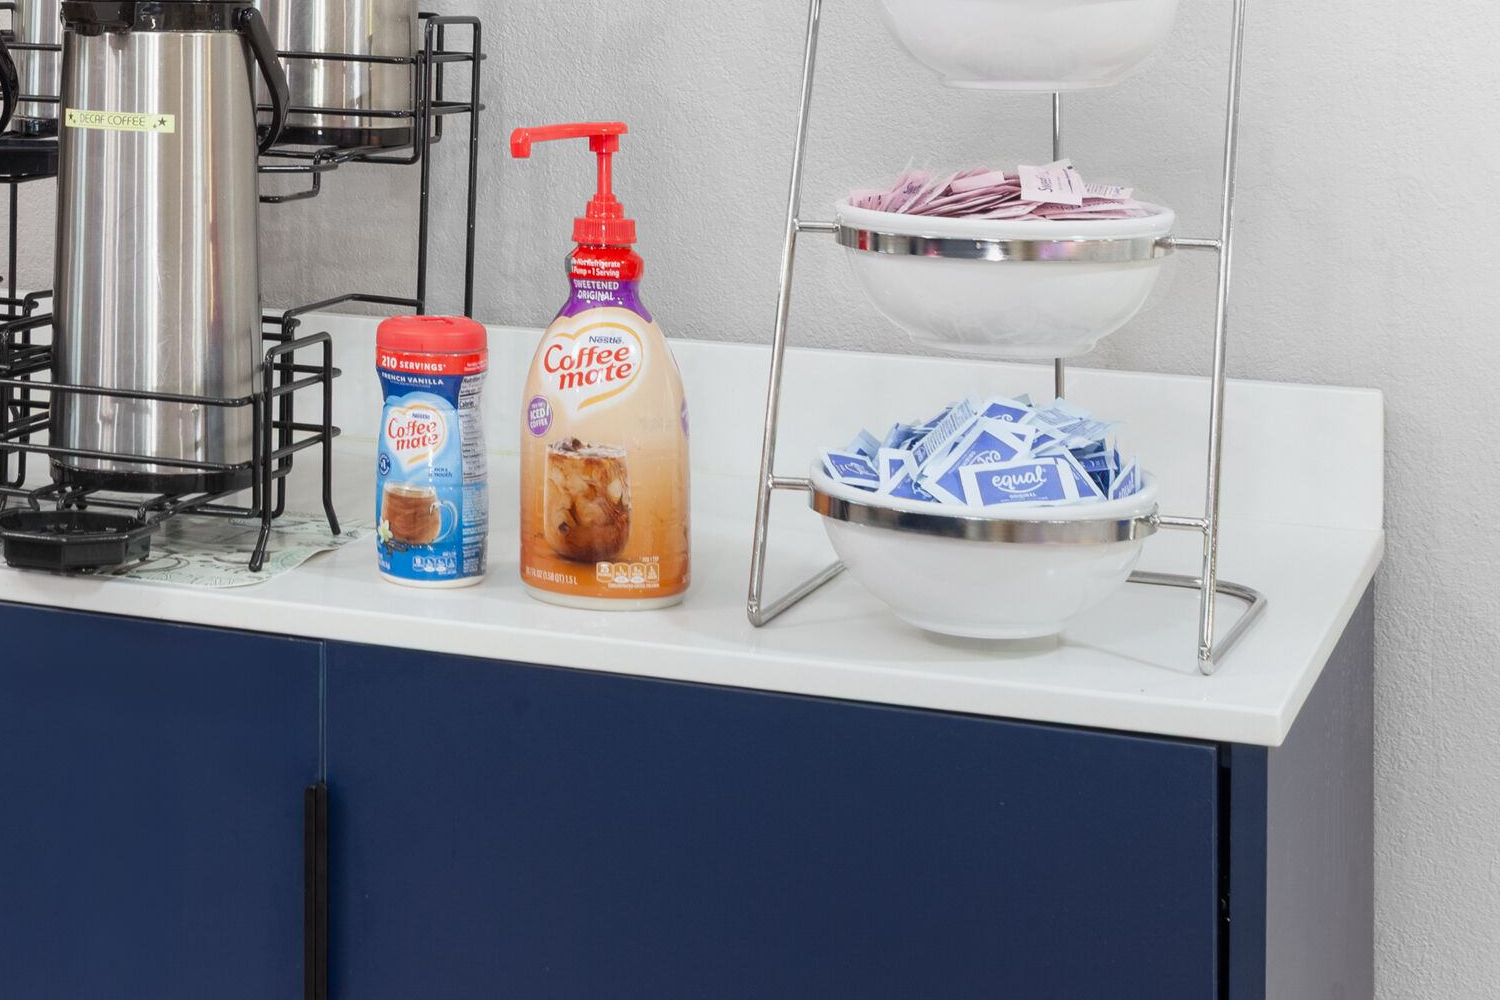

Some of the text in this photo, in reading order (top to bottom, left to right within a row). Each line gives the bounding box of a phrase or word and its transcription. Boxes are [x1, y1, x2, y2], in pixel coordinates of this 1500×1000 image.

[80, 113, 146, 126] DECAF COFFEE
[596, 268, 620, 279] Serving
[573, 278, 620, 291] SWEETENED
[577, 290, 615, 302] ORIGINAL
[382, 355, 398, 369] 210
[543, 343, 630, 374] Coffee
[381, 372, 406, 382] FRENCH
[407, 377, 445, 386] VANILLA
[559, 362, 633, 391] mate
[388, 418, 437, 439] Coffee
[396, 433, 439, 452] mate
[991, 465, 1047, 490] equal
